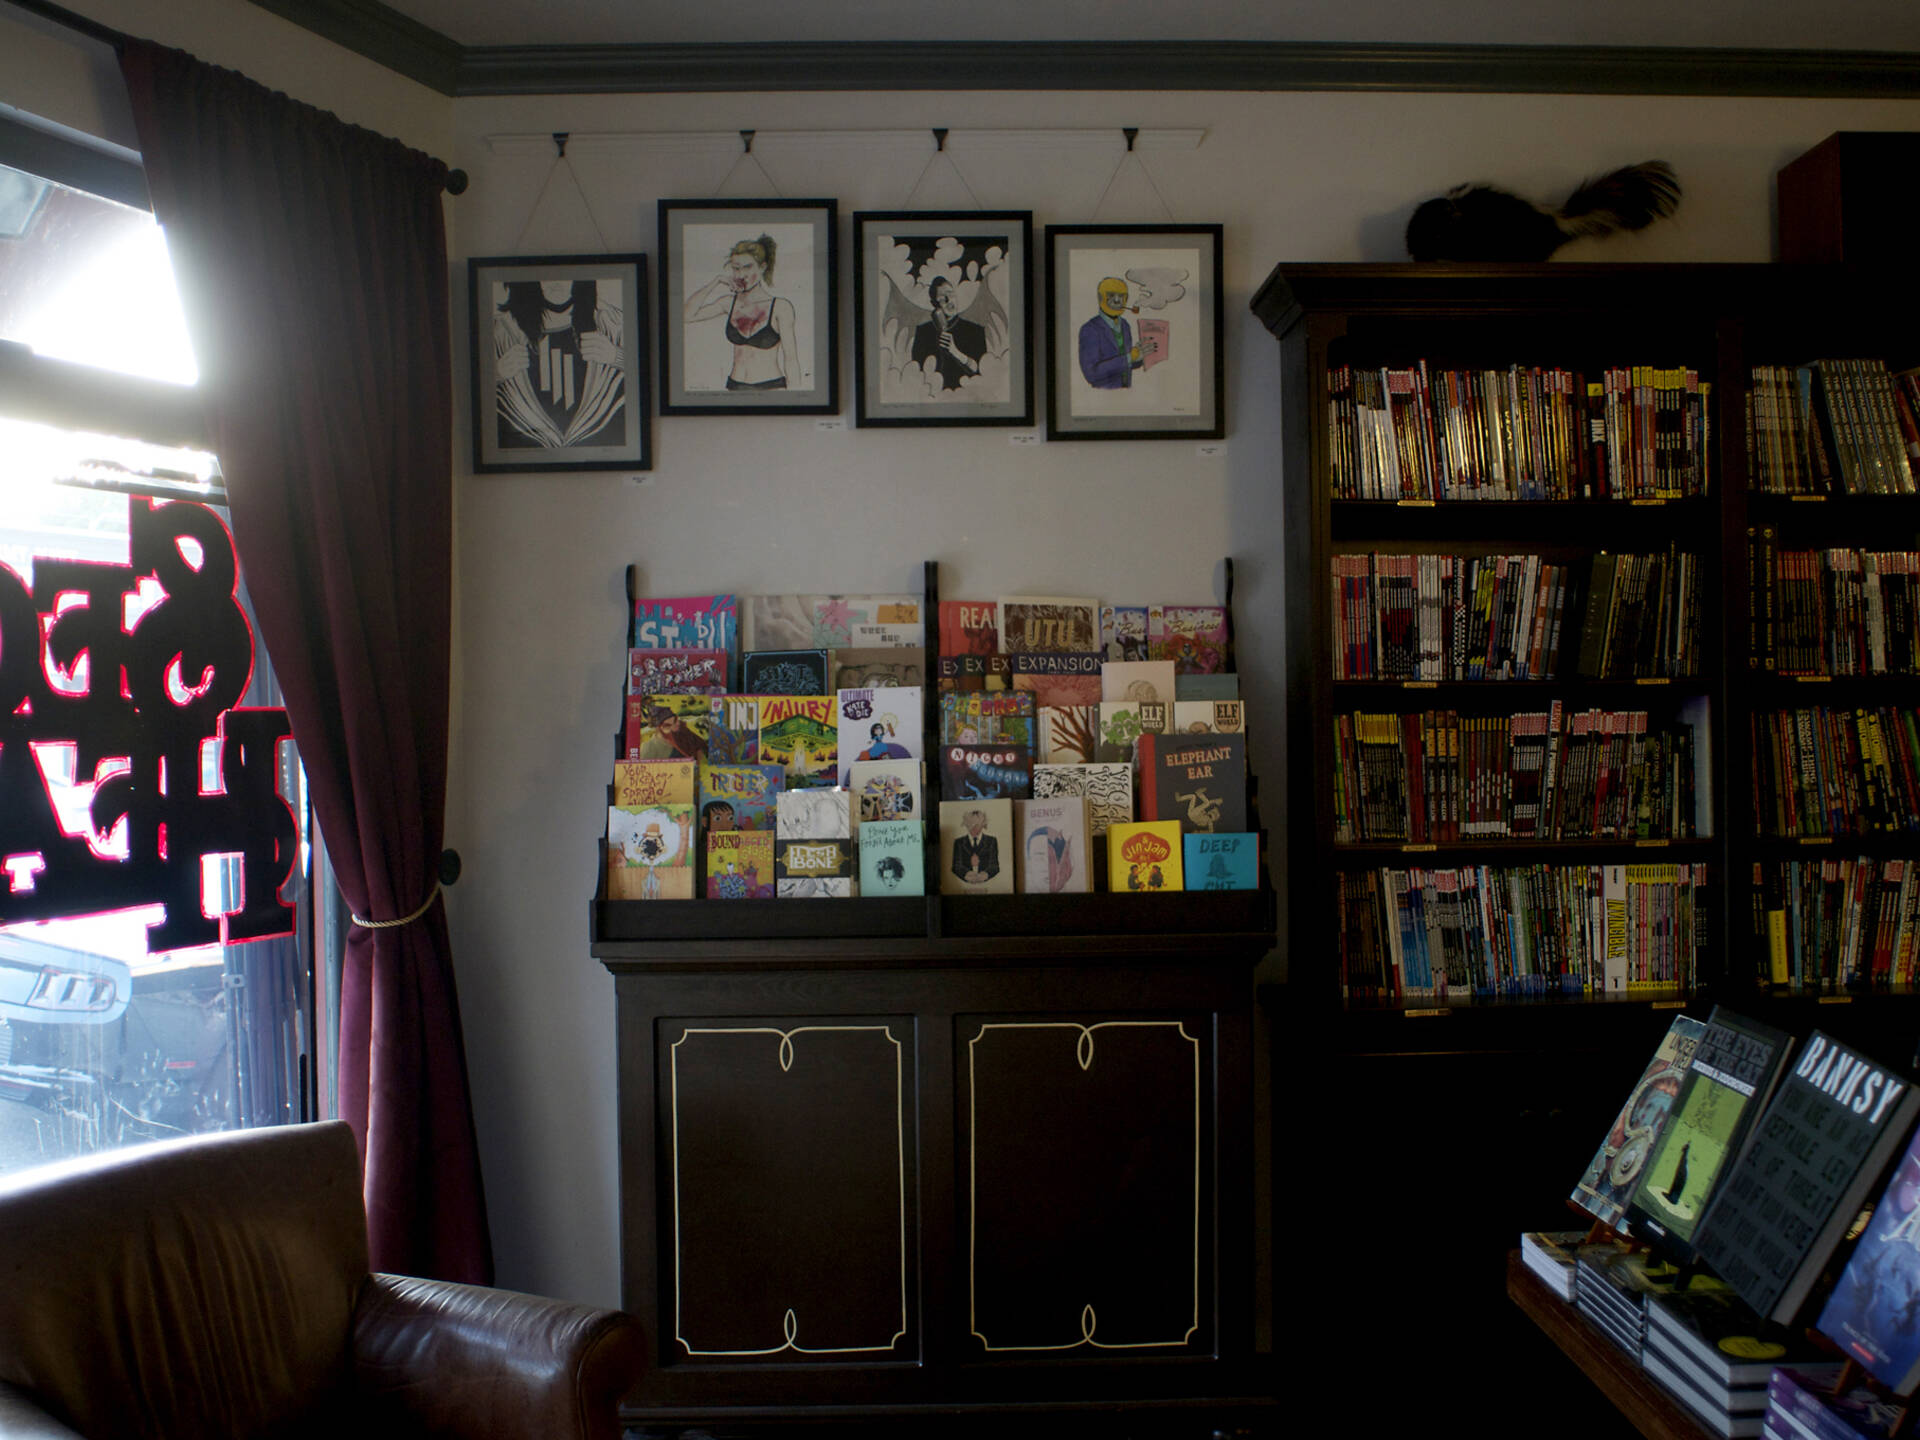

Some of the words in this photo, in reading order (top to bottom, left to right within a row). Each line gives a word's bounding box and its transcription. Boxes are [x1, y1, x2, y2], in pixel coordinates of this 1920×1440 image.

[1590, 419, 1605, 443] JINX
[1025, 619, 1074, 647] UTU
[966, 658, 983, 672] EX
[1019, 656, 1104, 672] EXPANSION
[763, 699, 832, 724] INJURY
[1142, 705, 1163, 720] ELF
[1216, 704, 1238, 719] ELF
[1165, 746, 1231, 767] ELEPHANT
[1187, 765, 1213, 780] EAR
[711, 834, 740, 849] BOUND
[1200, 838, 1240, 854] DEEP
[790, 857, 837, 870] BONE
[1607, 900, 1625, 959] INVINCIBLE
[1796, 1036, 1904, 1124] BANKSY
